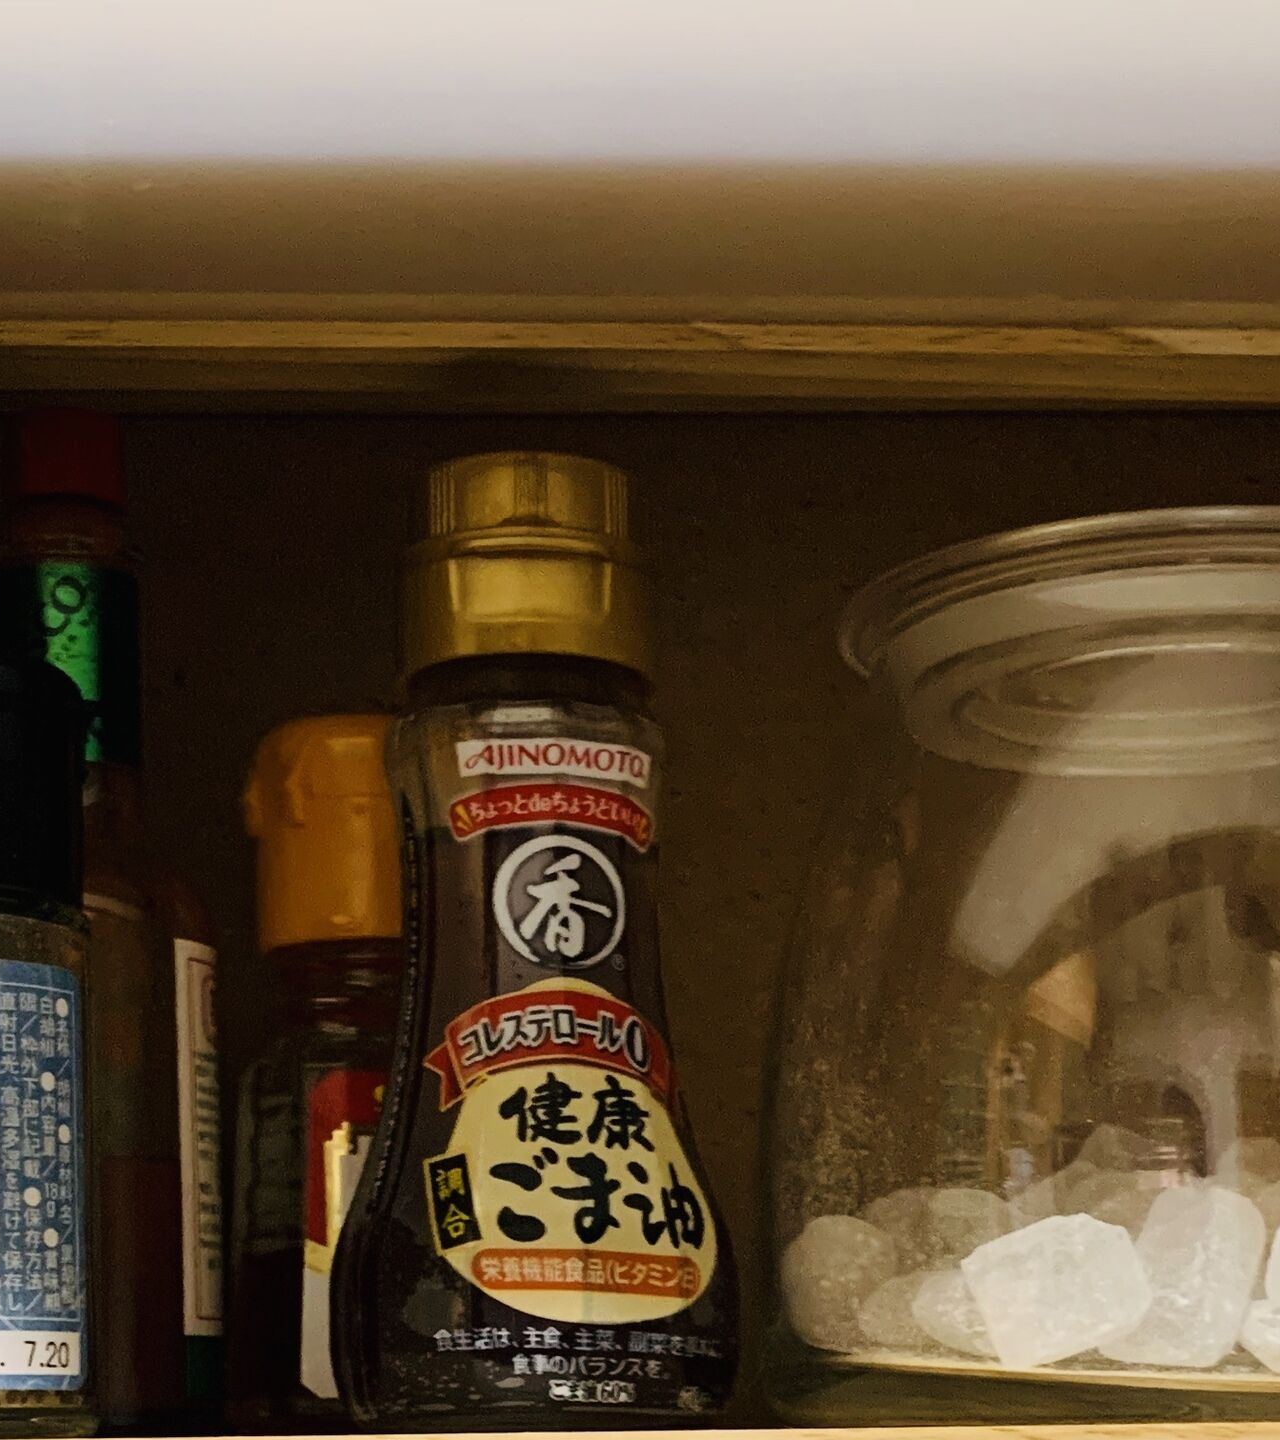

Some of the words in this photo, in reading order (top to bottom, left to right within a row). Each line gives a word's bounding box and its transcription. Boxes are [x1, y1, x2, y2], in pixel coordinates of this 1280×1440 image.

[465, 743, 644, 778] AJINOMOTO
[519, 853, 611, 958] 香
[458, 1006, 651, 1073] コレステロール0
[498, 1071, 656, 1152] 健康
[435, 1166, 471, 1239] 調合
[489, 1147, 706, 1250] ごま油
[24, 1340, 70, 1368] 7.20
